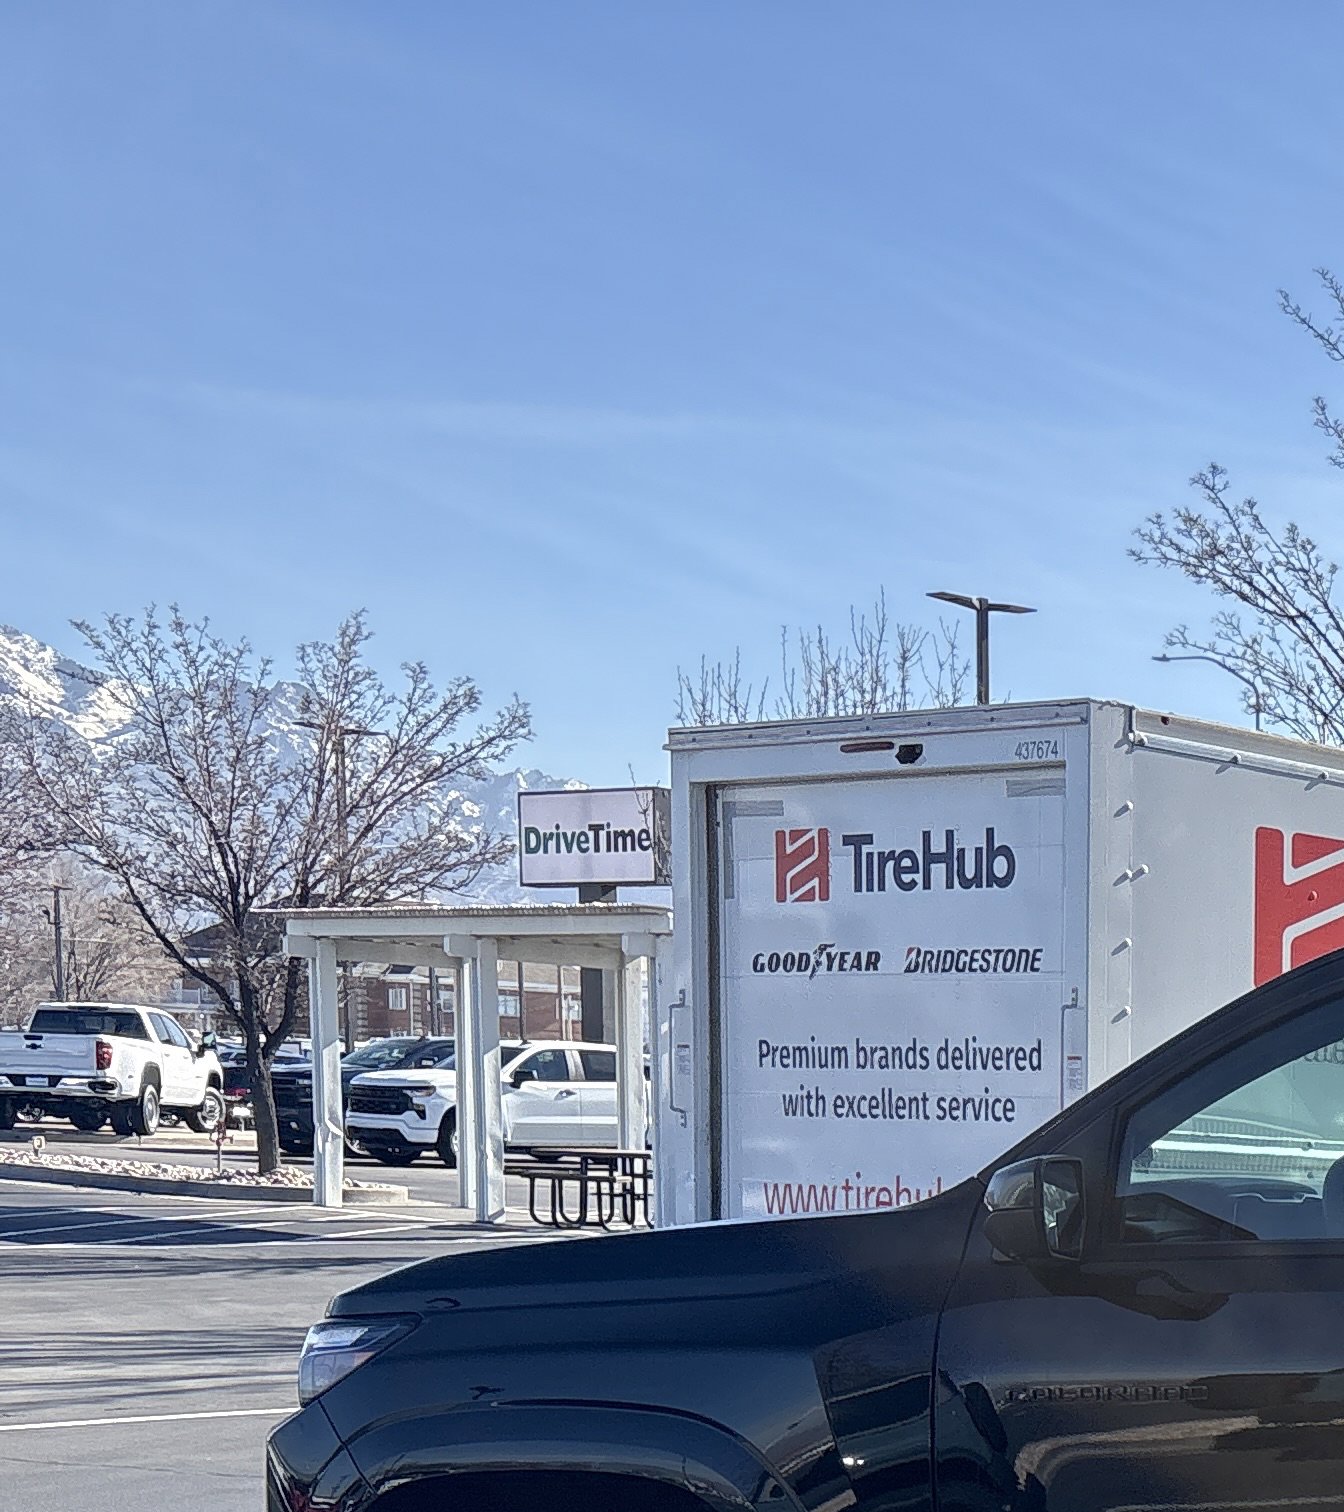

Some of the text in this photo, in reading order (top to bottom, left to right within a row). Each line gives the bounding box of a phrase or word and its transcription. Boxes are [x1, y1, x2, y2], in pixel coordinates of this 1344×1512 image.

[1014, 740, 1059, 760] 437674
[523, 822, 651, 854] DriveTime
[842, 827, 1016, 892] TireHub
[752, 946, 881, 977] GOODYEAR
[903, 946, 1043, 974] BRIDGESTONE
[758, 1036, 1042, 1071] Premium brands delivered
[782, 1084, 1016, 1122] with excellent service
